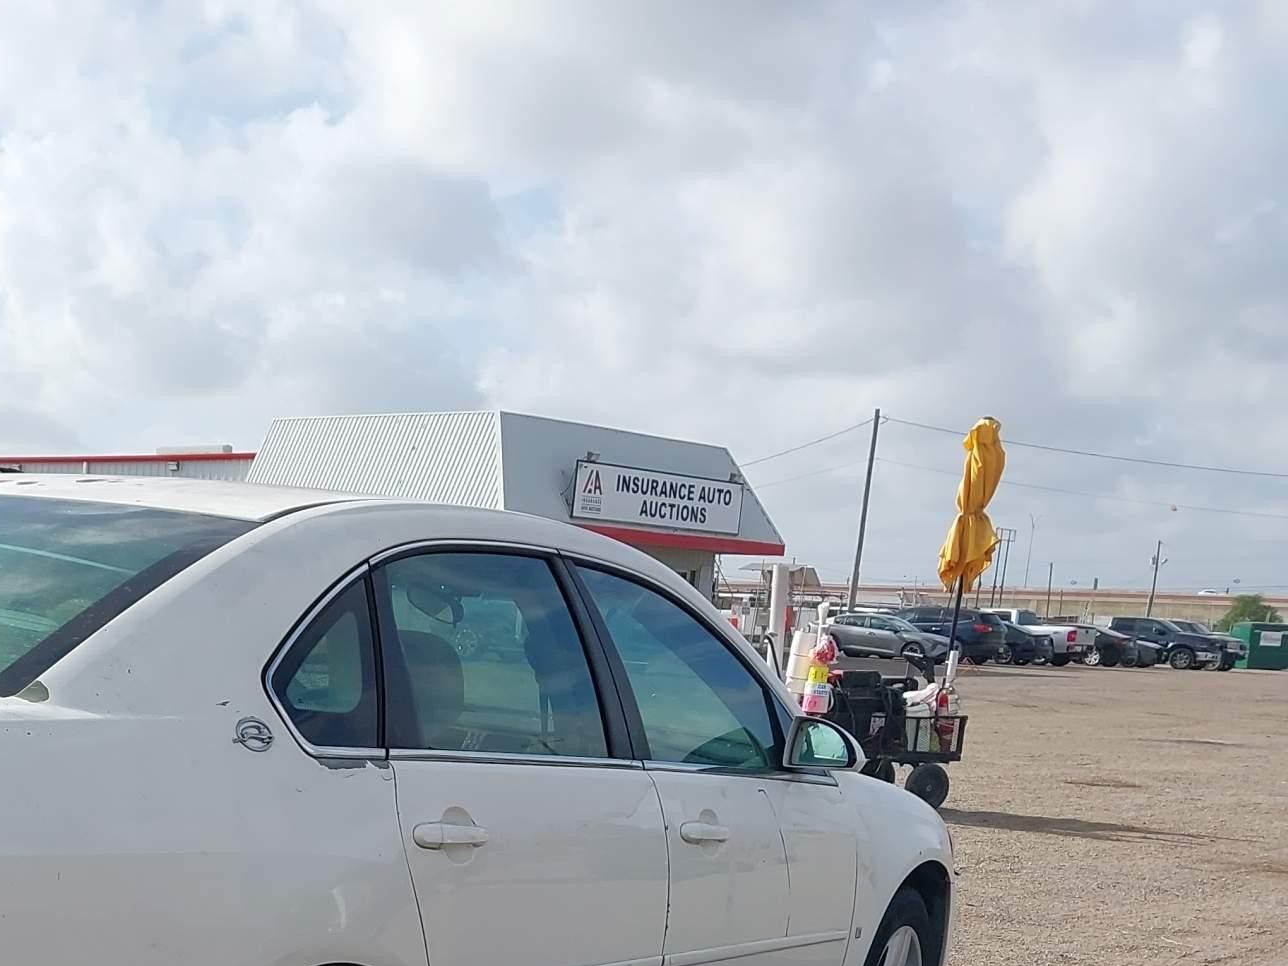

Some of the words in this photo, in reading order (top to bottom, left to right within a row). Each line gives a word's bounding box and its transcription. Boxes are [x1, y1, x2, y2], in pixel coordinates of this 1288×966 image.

[616, 474, 695, 501] INSURANCE
[698, 486, 732, 506] AUTO
[640, 500, 707, 524] AUCTIONS
